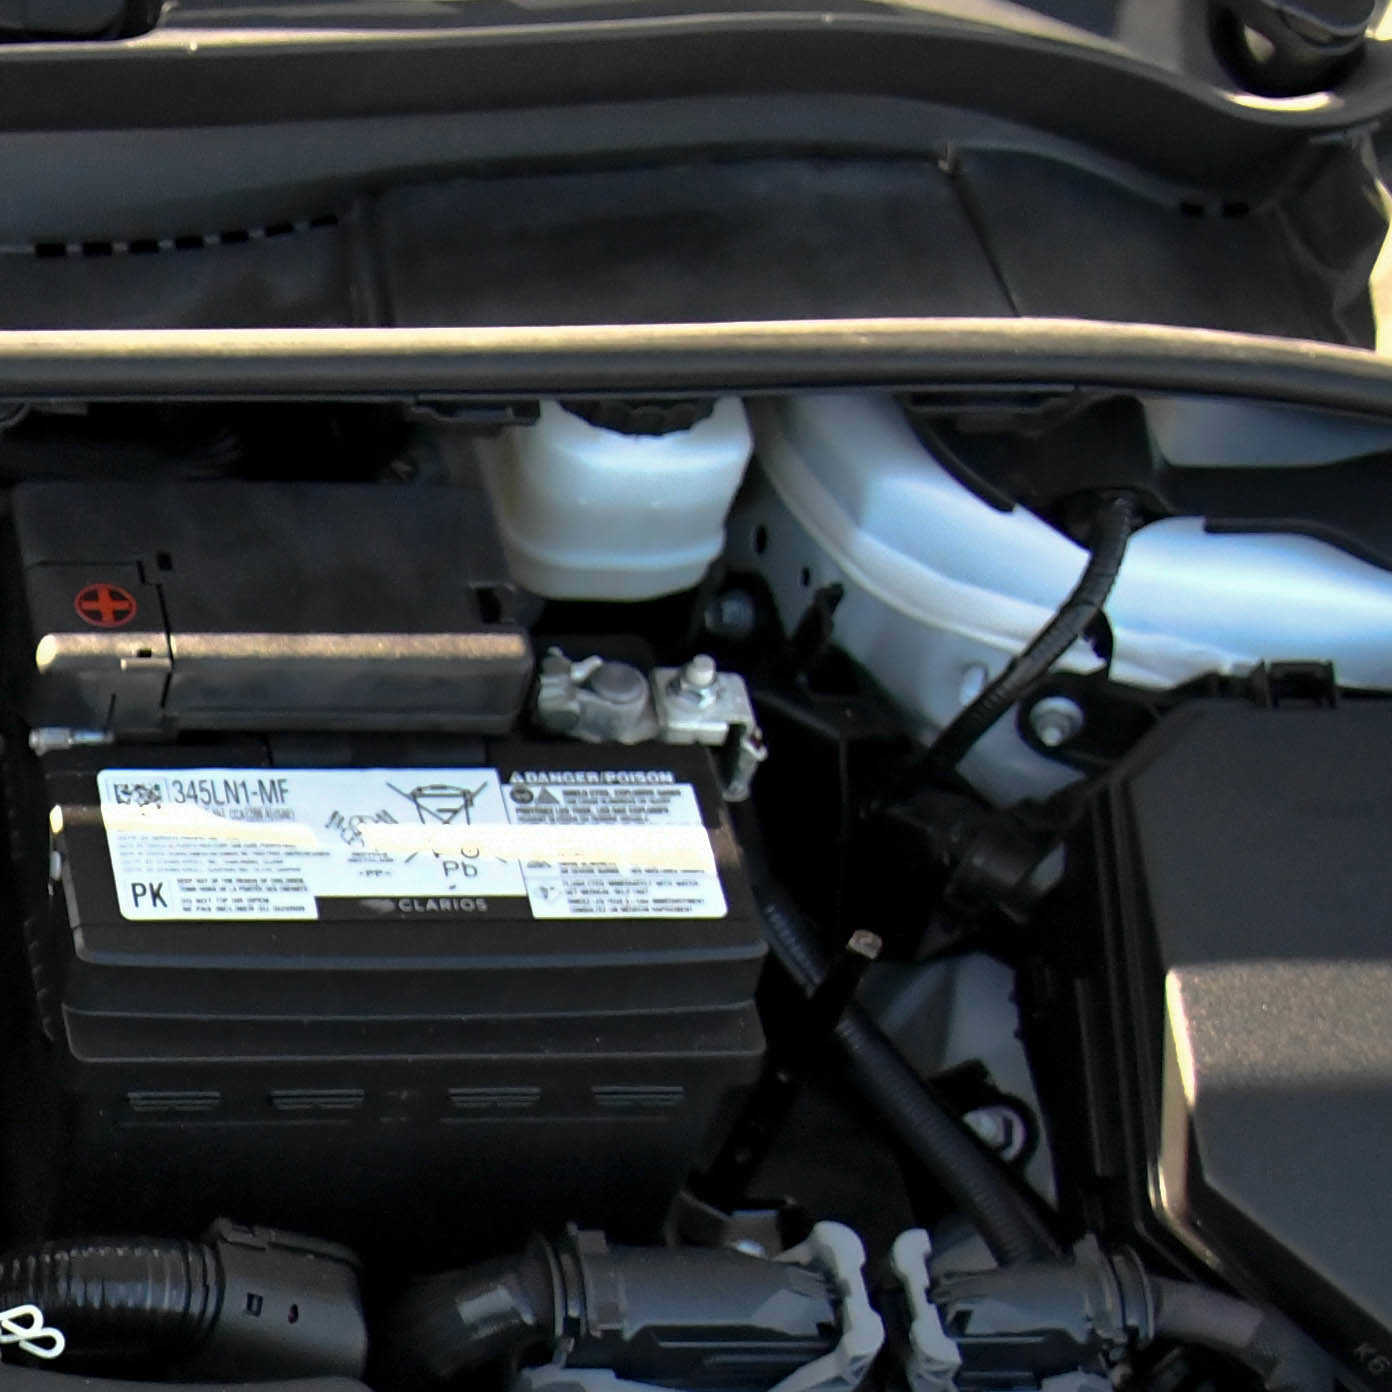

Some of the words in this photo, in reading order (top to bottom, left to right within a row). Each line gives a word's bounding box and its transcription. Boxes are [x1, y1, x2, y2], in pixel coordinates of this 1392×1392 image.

[172, 779, 288, 805] 345LN1-MF
[442, 861, 478, 877] Pb
[131, 882, 168, 908] PK
[398, 898, 488, 912] CLARIOS
